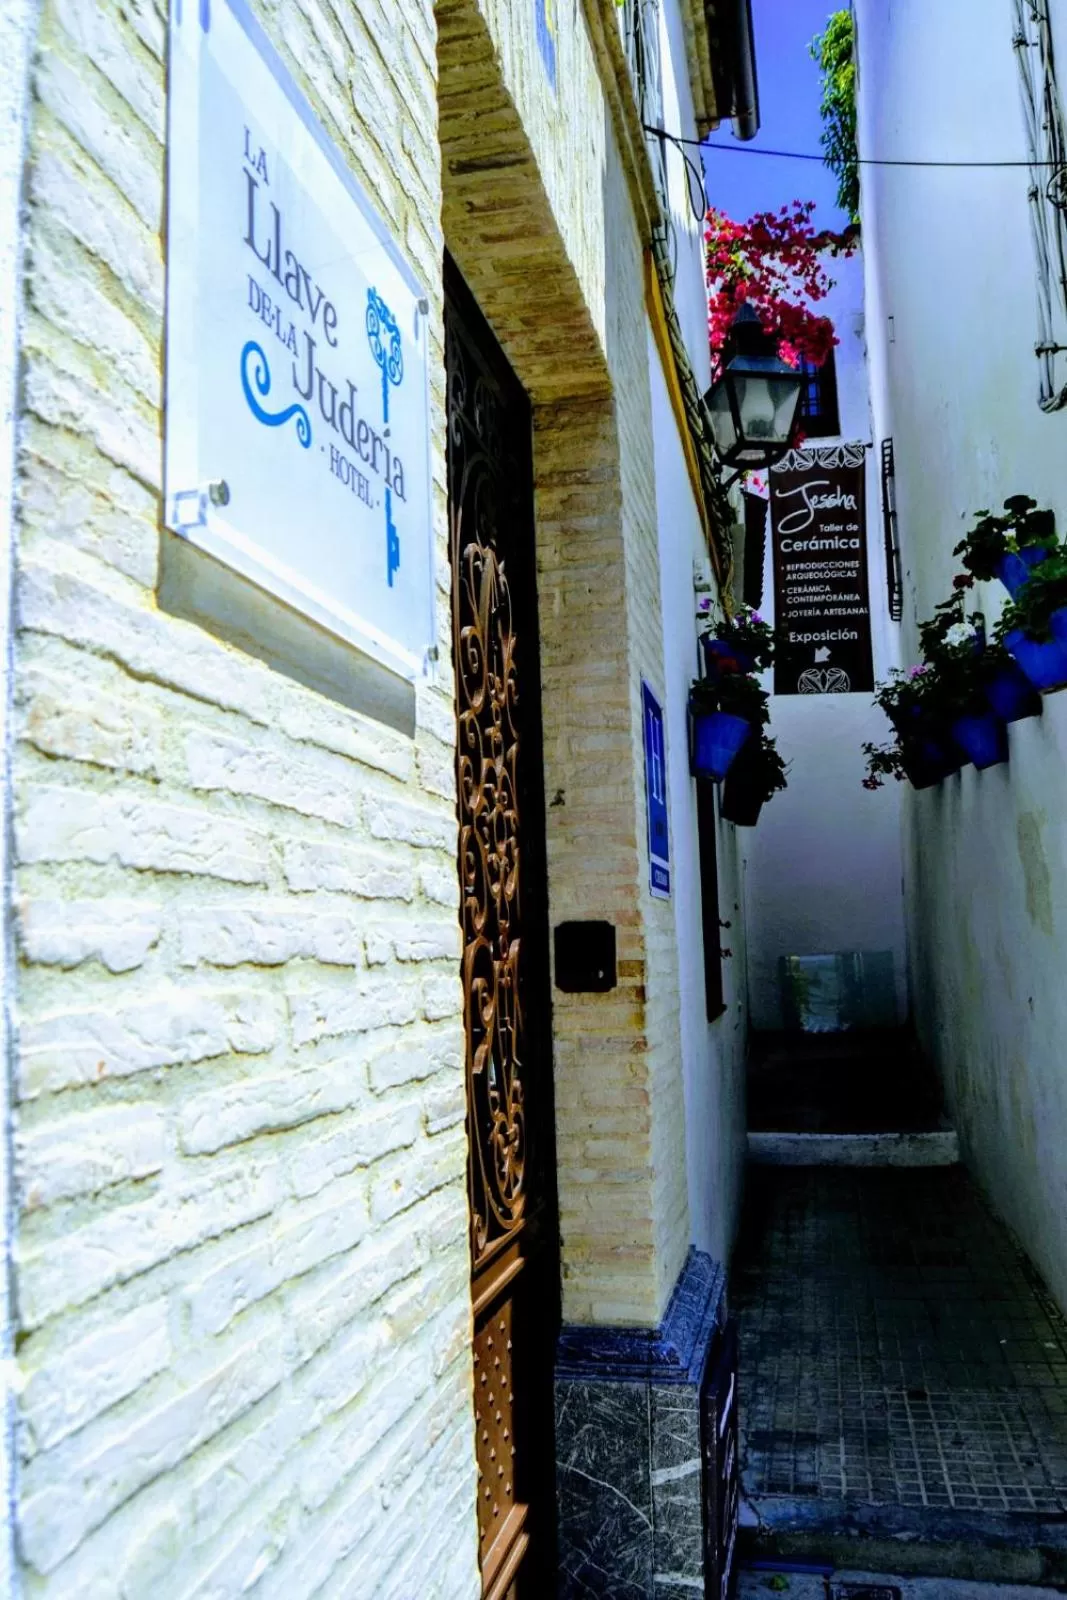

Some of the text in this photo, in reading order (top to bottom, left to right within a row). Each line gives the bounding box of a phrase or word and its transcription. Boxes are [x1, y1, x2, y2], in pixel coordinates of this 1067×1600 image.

[243, 125, 270, 186] LA
[243, 166, 338, 348] Llave
[329, 443, 374, 509] HOTEL
[819, 523, 859, 532] Taller de
[780, 535, 860, 553] Cerámica
[786, 561, 860, 571] REPRODUCCIONES
[785, 569, 857, 580] ARQUEOLÓGICAS
[786, 585, 831, 595] CERÁMICA
[786, 592, 860, 604] CONTEMPORÁNEA
[787, 606, 868, 618] JOYERÍA ARTESANAL
[789, 628, 858, 643] Exposición
